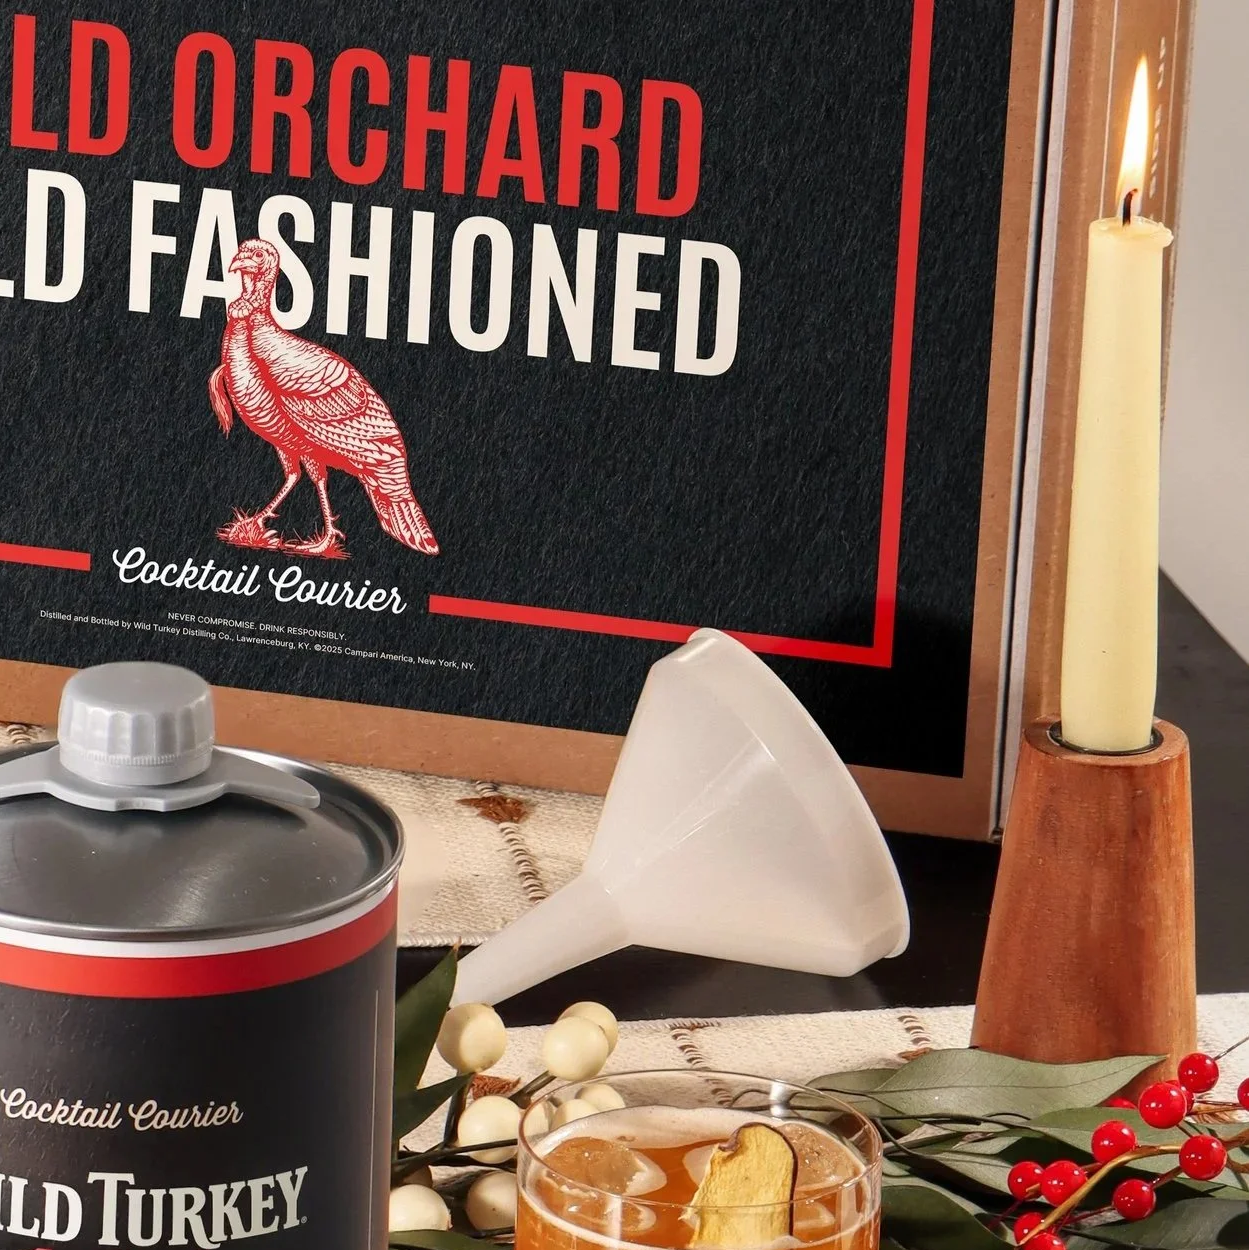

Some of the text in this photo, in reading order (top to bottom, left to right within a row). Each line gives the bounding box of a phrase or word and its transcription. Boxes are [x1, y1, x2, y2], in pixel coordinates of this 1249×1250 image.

[173, 31, 704, 218] ORCHARD
[128, 180, 741, 378] FASHIONED
[112, 546, 407, 614] Cocktail Courier
[40, 610, 71, 621] Distilled
[73, 613, 89, 623] and
[91, 616, 120, 627] Bottled
[121, 619, 132, 630] by
[133, 621, 151, 631] Wild
[153, 624, 180, 635] Turkey
[182, 627, 216, 640] Distilling
[218, 631, 234, 642] Co.,
[236, 634, 296, 650] Lawrenceburg,
[298, 642, 312, 651] KY.
[345, 647, 378, 660] Campari
[380, 651, 416, 664] America,
[417, 656, 436, 666] New
[438, 658, 459, 670] York,
[461, 662, 476, 671] NY.
[168, 612, 347, 641] NEVER COMPROMISE. DRINK RESPONSIBLY.
[0, 1087, 243, 1132] Cocktail Courier
[87, 1165, 308, 1250] TURKEY
